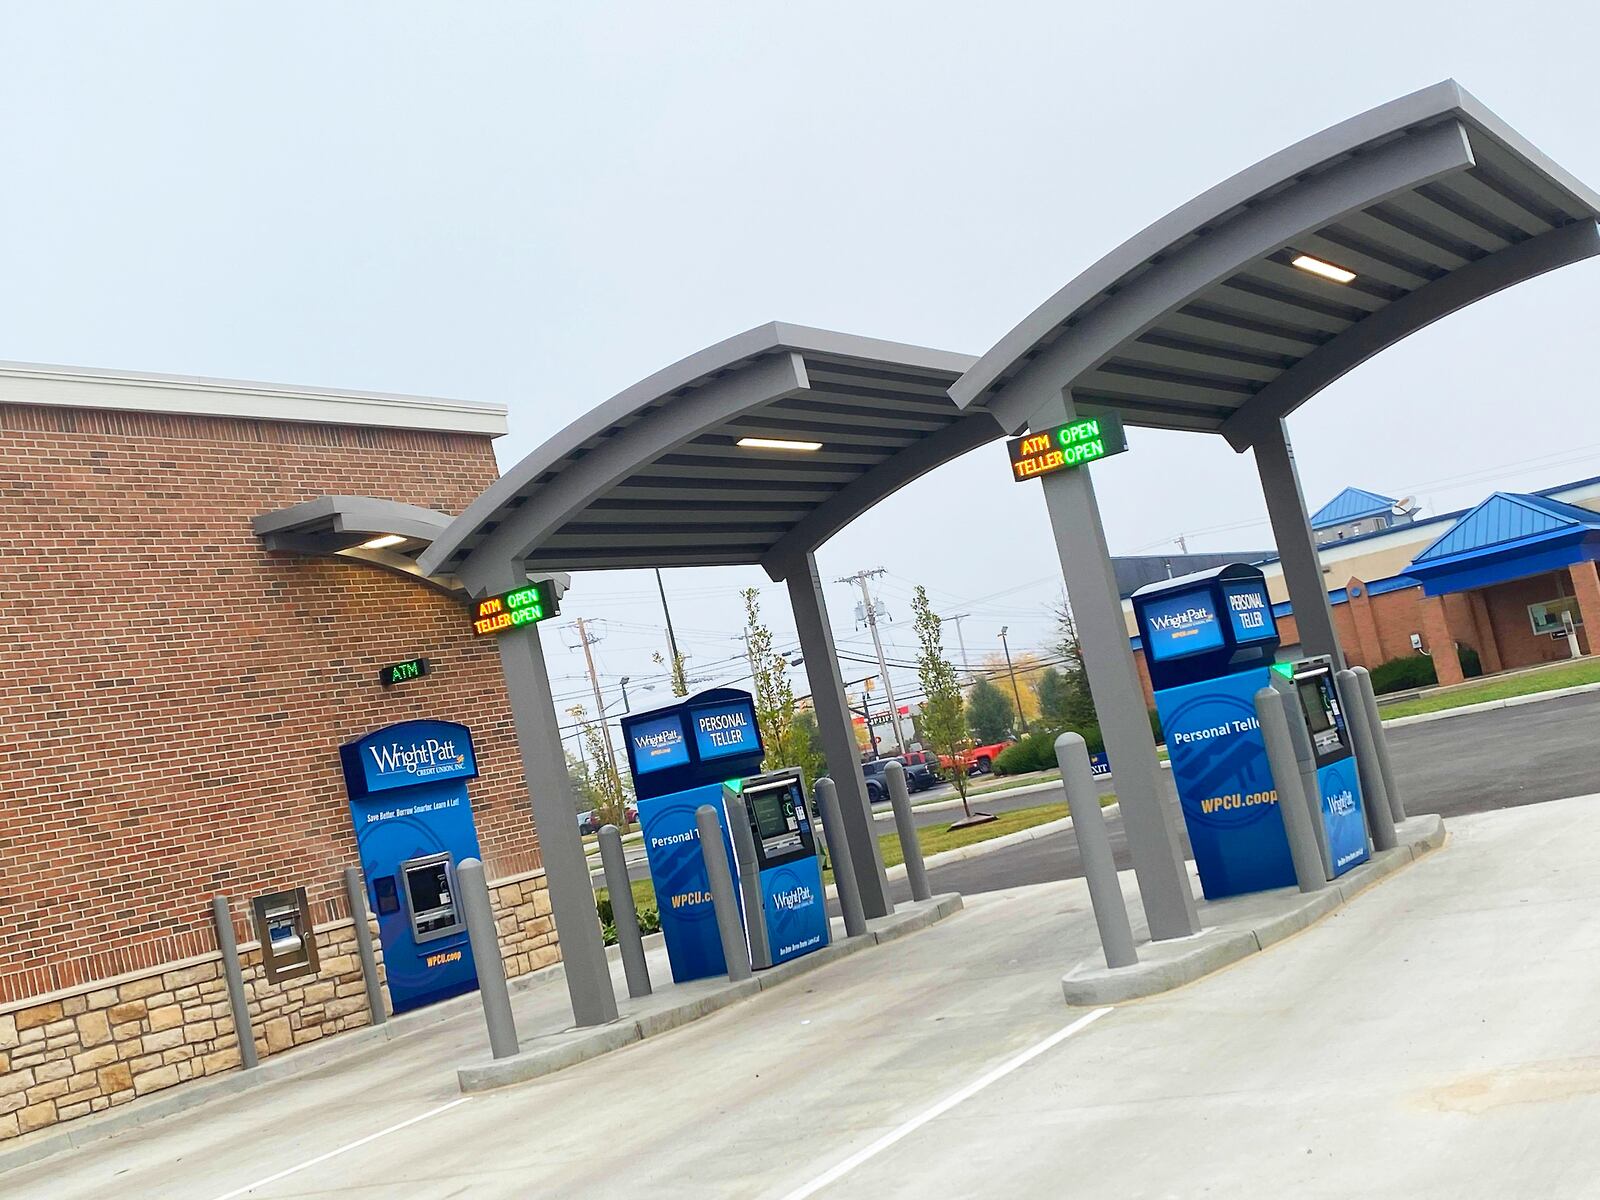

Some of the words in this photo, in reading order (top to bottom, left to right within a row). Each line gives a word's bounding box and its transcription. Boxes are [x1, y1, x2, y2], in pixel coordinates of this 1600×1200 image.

[1021, 434, 1050, 456] ATM
[1060, 420, 1099, 443] OPEN
[1015, 451, 1065, 476] TELLER
[1065, 439, 1104, 463] OPEN
[480, 599, 502, 616] ATM
[508, 589, 539, 608] OPEN
[1229, 592, 1265, 611] PERSONAL
[474, 613, 512, 634] TELLER
[512, 605, 543, 625] OPEN
[1239, 611, 1265, 629] TELLER
[392, 661, 419, 682] ATM
[699, 712, 748, 733] PERSONAL
[1174, 722, 1231, 745] Personal
[1232, 716, 1261, 733] Tell
[710, 729, 744, 747] TELLER
[416, 766, 436, 777] CREDIT
[1090, 763, 1108, 775] XIT
[1201, 790, 1278, 814] WPCU.coop
[652, 829, 694, 848] Personal
[671, 891, 713, 909] WPCU.c
